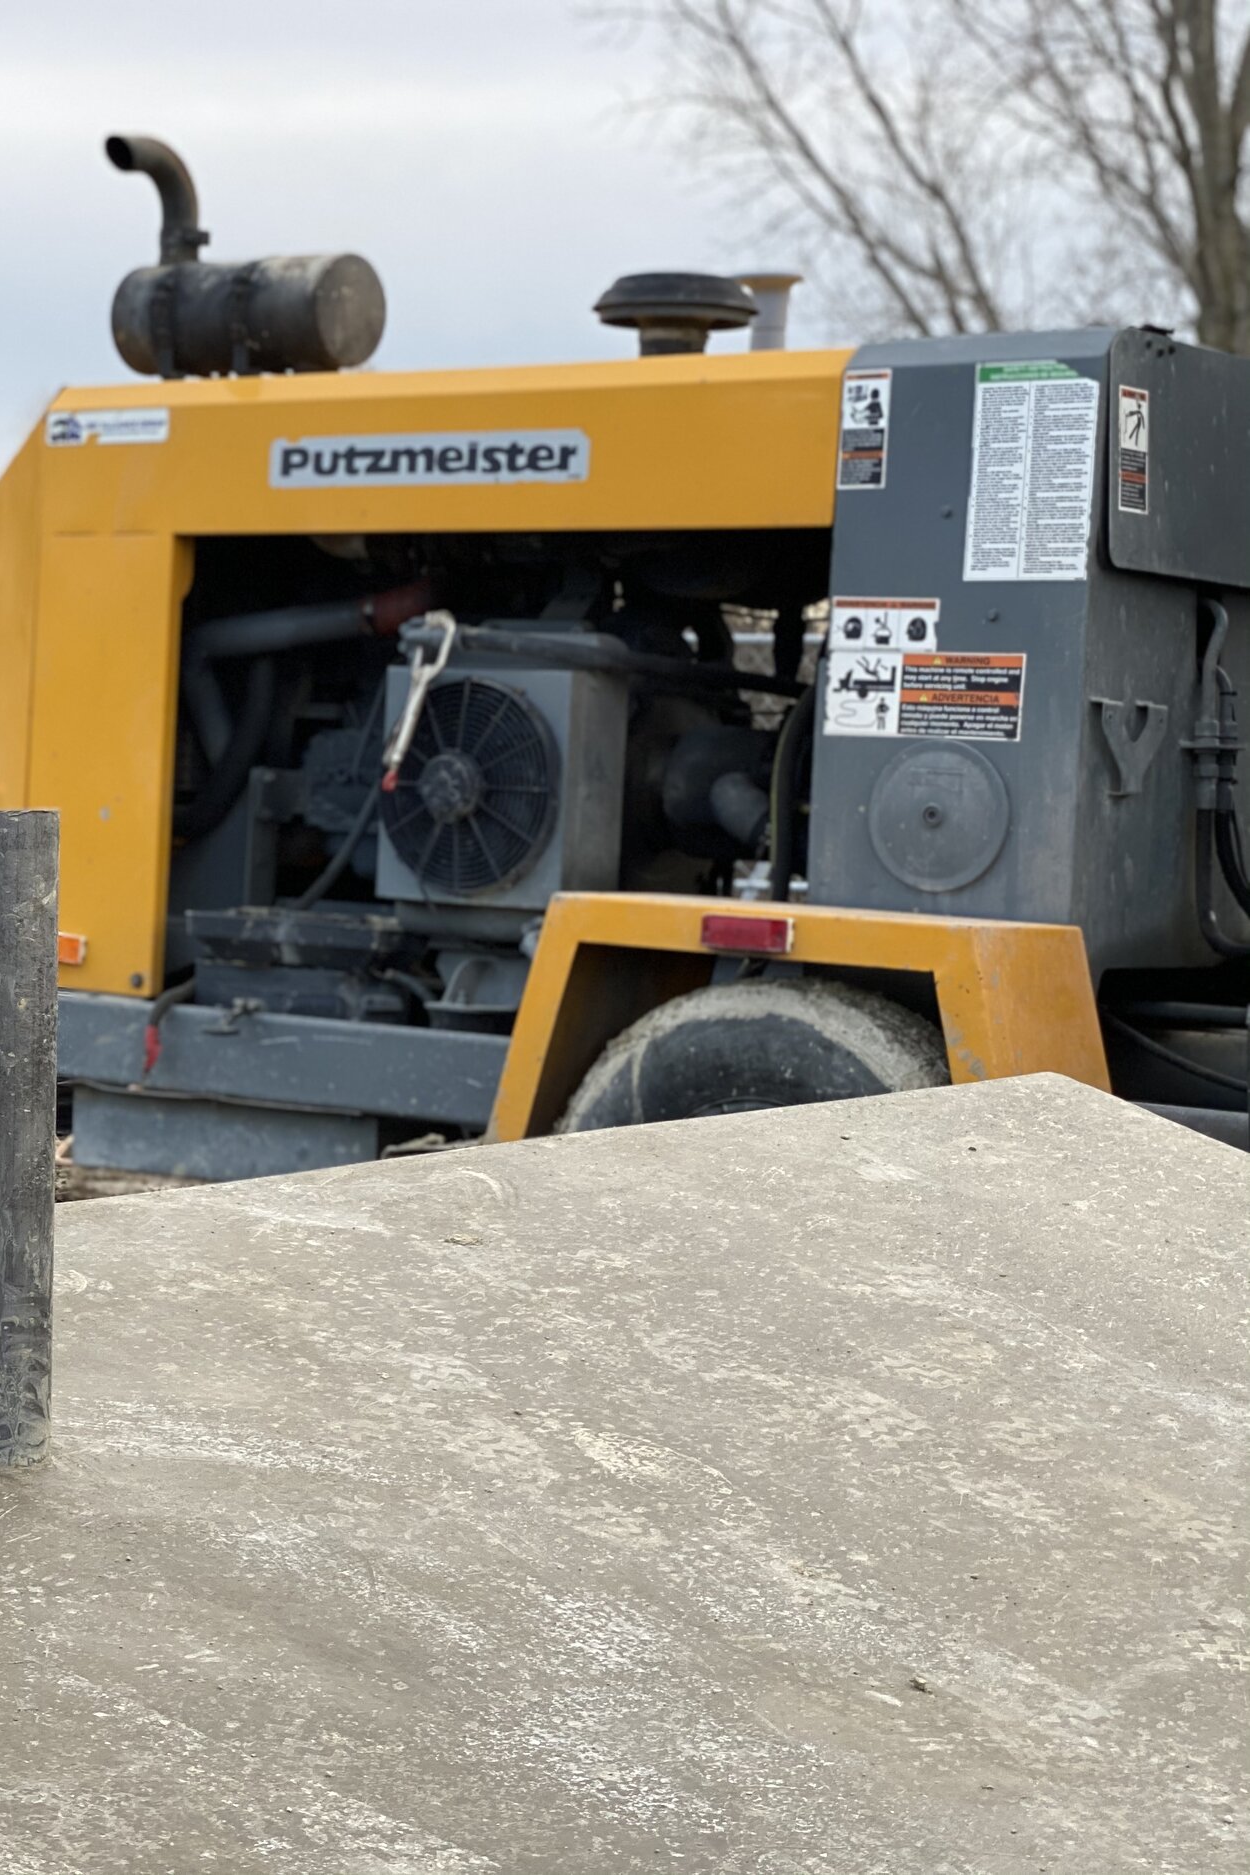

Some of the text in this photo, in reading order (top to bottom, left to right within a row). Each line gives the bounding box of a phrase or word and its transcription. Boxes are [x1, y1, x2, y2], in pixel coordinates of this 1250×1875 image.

[280, 441, 578, 477] Putzmeister
[946, 656, 990, 665] WARNING
[931, 693, 999, 703] ADVERTENCIA
